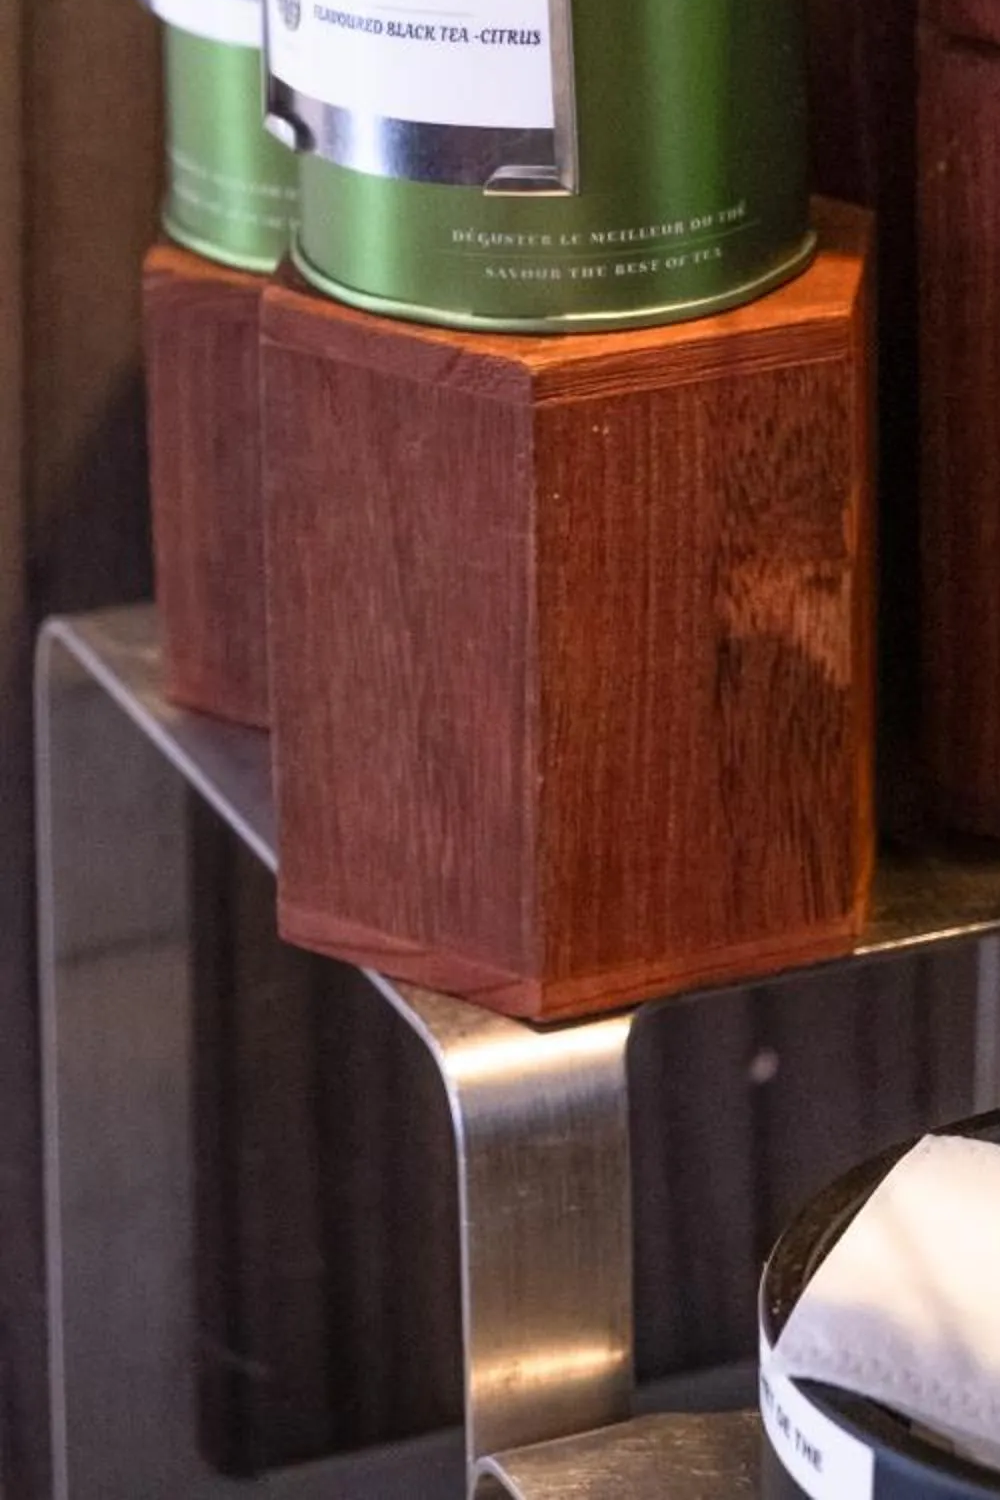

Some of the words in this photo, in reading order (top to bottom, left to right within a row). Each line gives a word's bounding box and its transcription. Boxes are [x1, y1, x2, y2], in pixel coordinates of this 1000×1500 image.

[313, 4, 383, 34] FLAVOURED
[387, 21, 436, 41] BLACK
[439, 26, 469, 43] TEA
[590, 221, 684, 244] MEILLEUR
[615, 259, 660, 275] BEST
